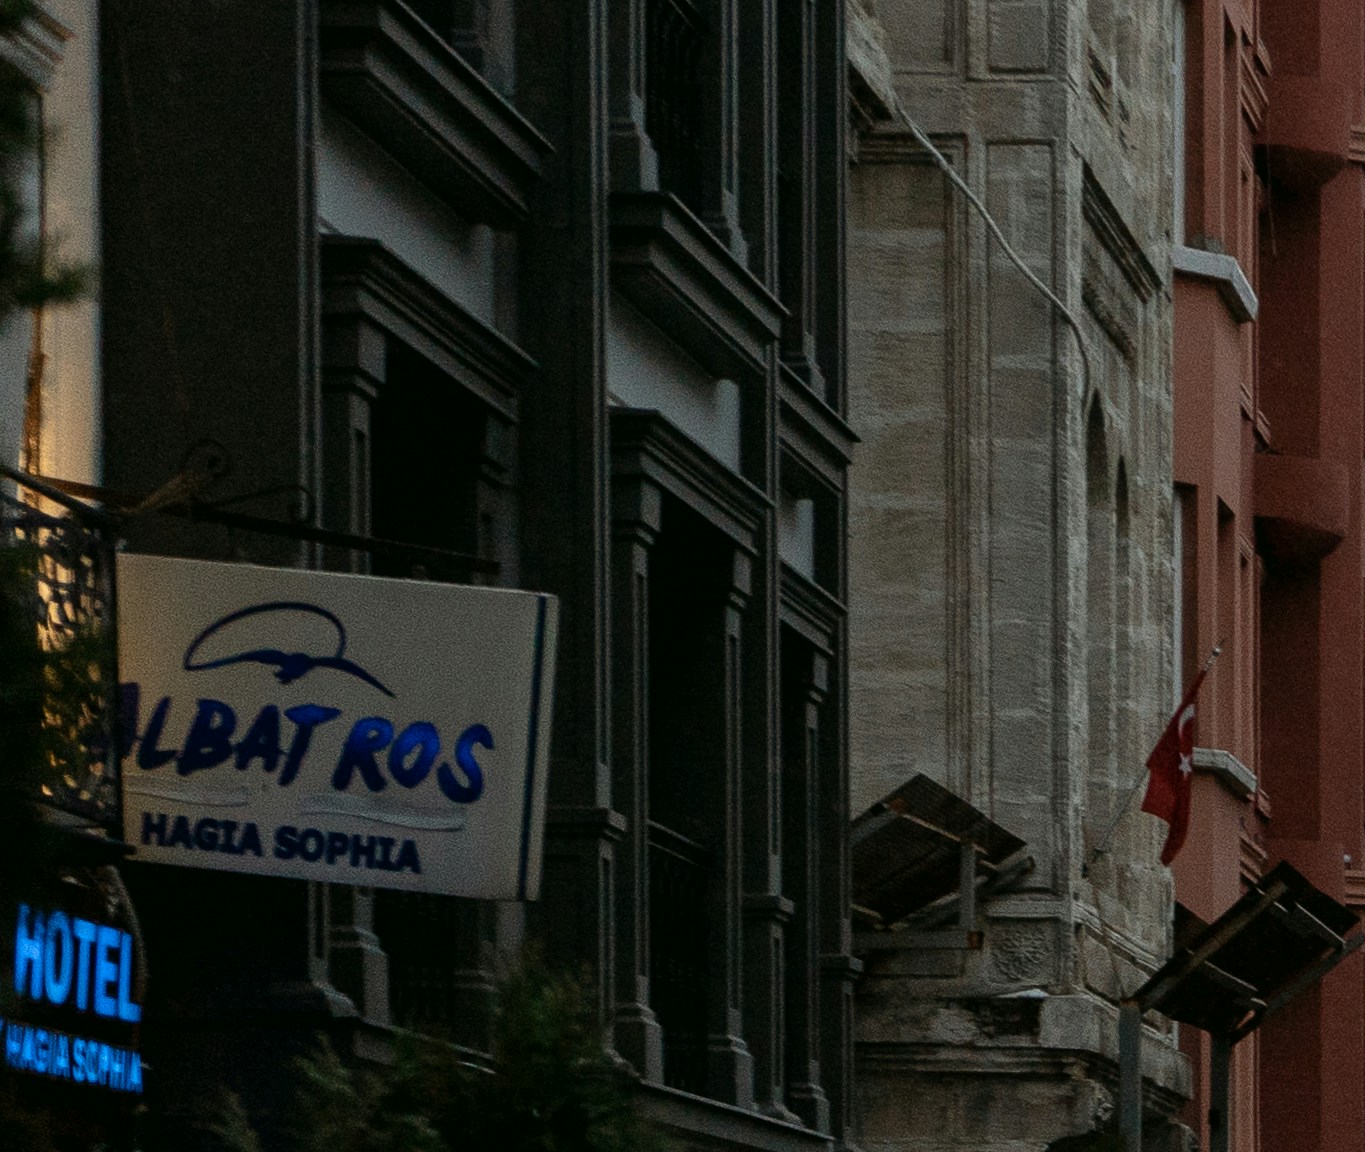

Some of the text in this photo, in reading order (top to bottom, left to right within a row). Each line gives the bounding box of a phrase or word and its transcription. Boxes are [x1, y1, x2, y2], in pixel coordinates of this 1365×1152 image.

[141, 812, 422, 874] HAGIA SOPHIA
[14, 900, 143, 1024] HOTEL
[5, 1022, 145, 1097] HAGIA SOPHIA
